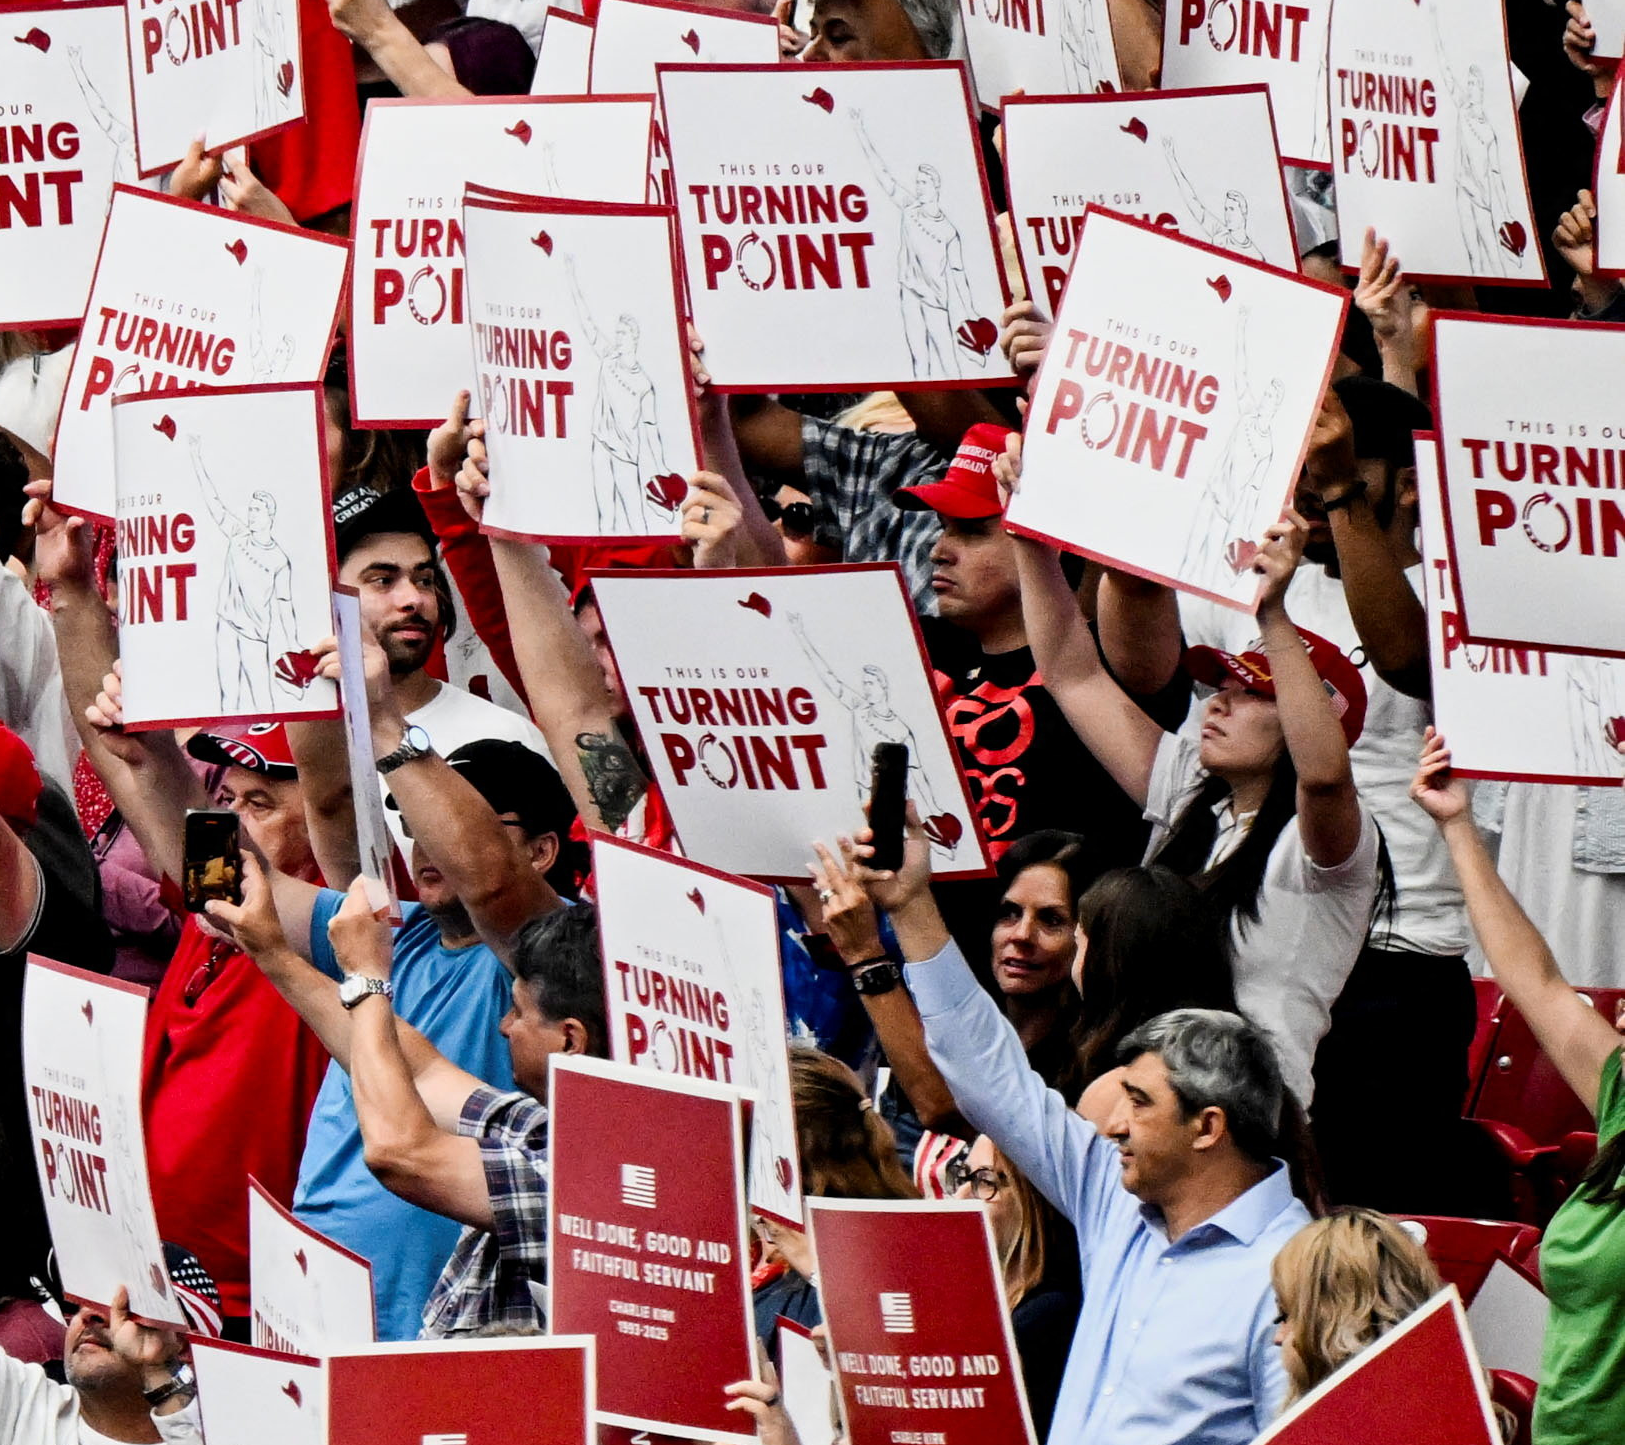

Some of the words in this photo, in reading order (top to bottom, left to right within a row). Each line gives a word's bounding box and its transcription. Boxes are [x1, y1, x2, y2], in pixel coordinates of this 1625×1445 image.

[720, 164, 756, 175] THIS
[766, 164, 781, 175] IS
[791, 164, 825, 175] OUR
[689, 184, 869, 225] TURNING
[666, 667, 702, 679] THIS
[713, 667, 727, 679] IS
[736, 667, 769, 678] OUR
[638, 687, 818, 726] TURNING
